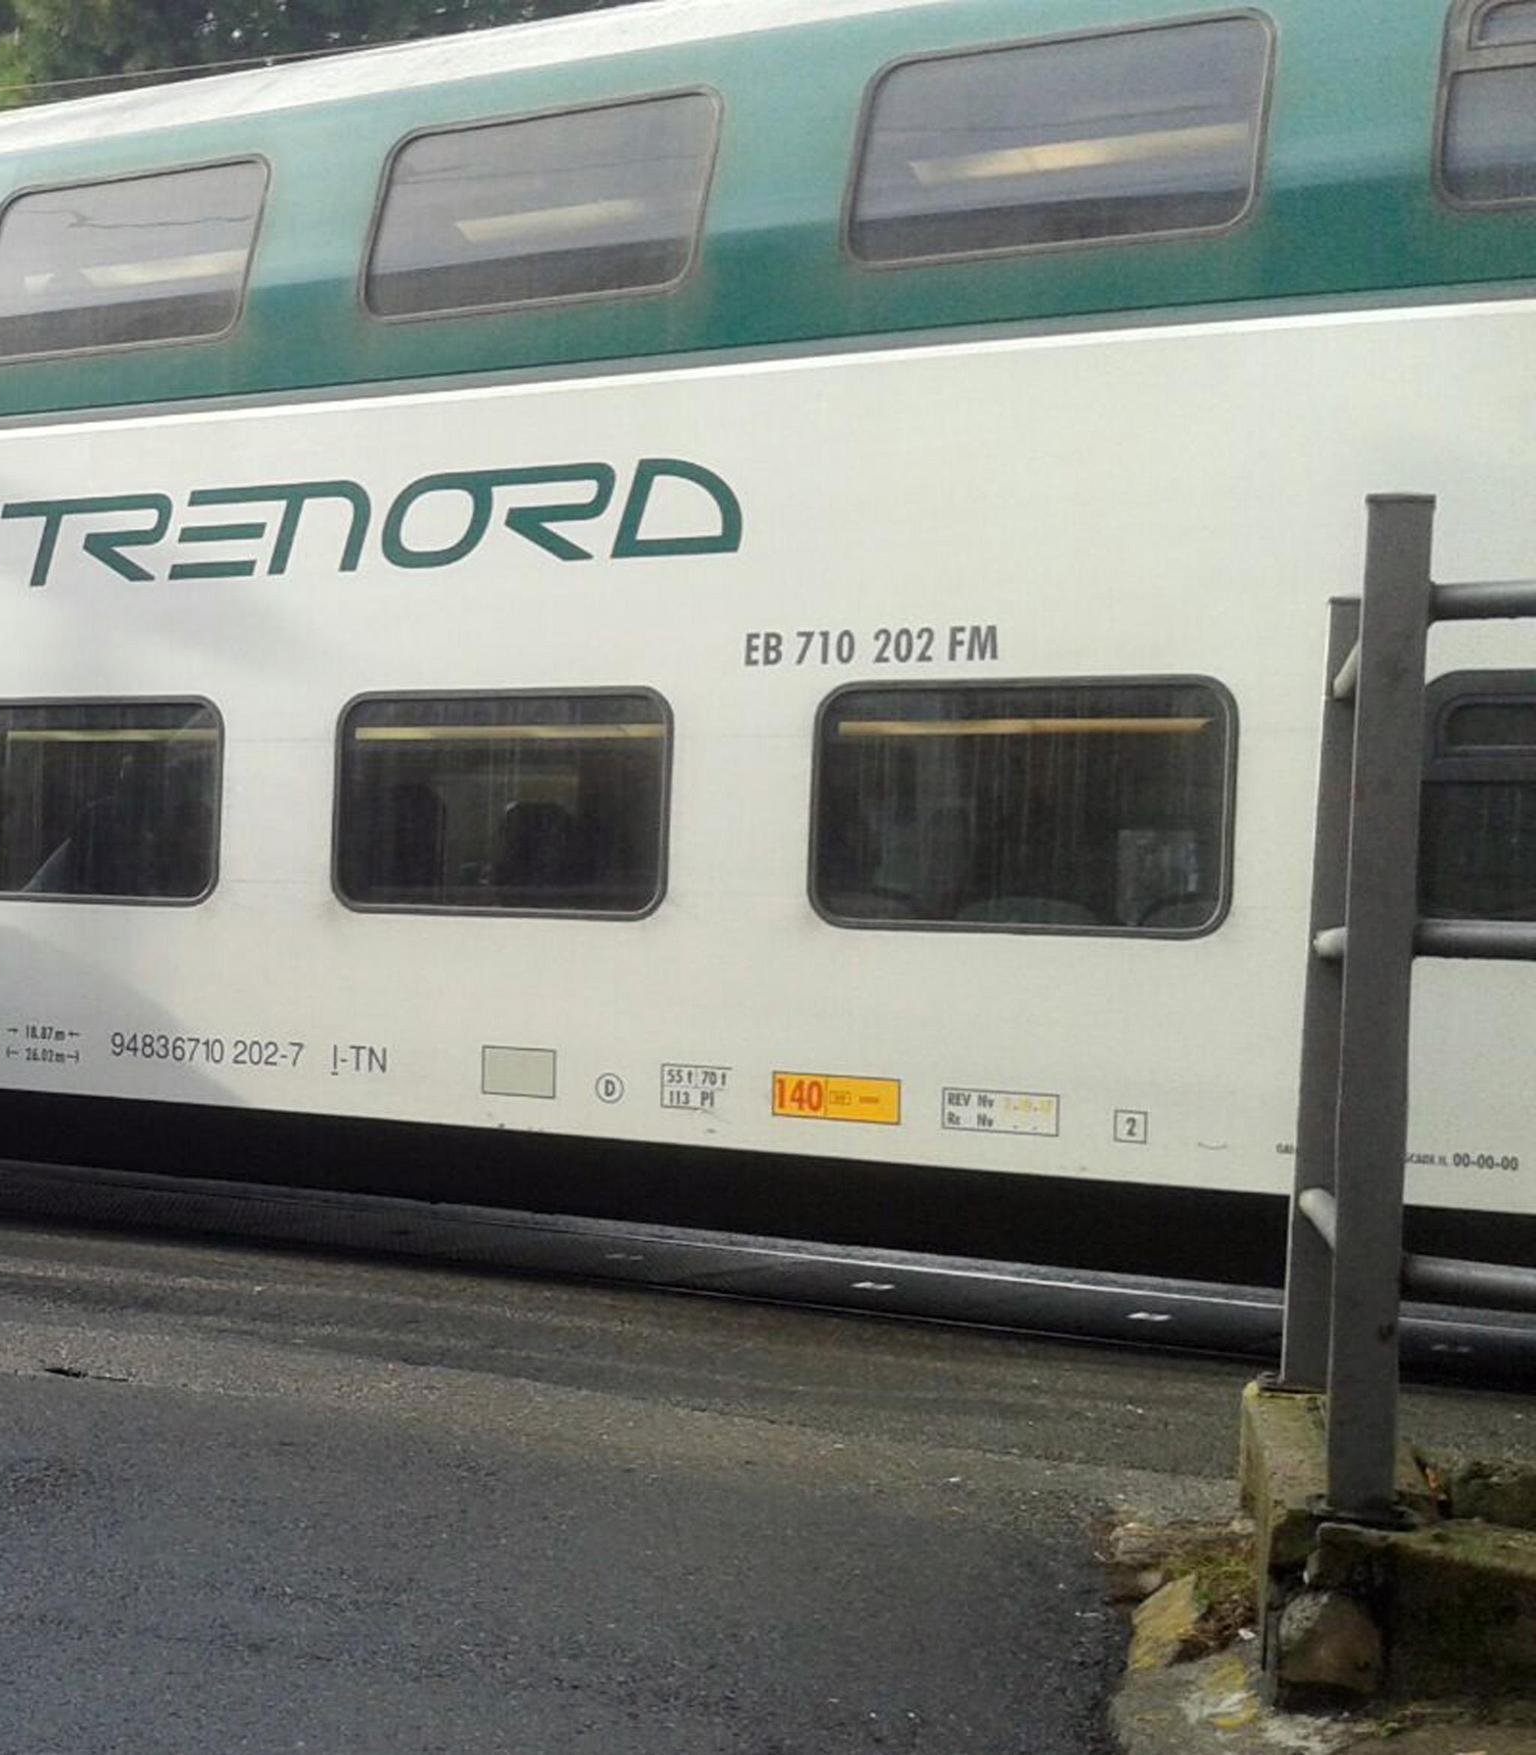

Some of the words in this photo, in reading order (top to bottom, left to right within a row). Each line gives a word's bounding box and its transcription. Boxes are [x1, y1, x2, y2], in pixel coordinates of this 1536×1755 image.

[1, 458, 742, 587] TRENORD
[744, 632, 783, 667] EB
[796, 630, 855, 665] 710
[873, 627, 934, 663] 202
[948, 625, 998, 661] FM
[110, 1031, 226, 1065] 94836710
[232, 1040, 305, 1067] 202-7
[604, 1079, 616, 1097] D
[666, 1069, 683, 1084] 55
[701, 1071, 718, 1086] 70
[669, 1091, 691, 1105] 113
[777, 1078, 823, 1112] 140
[1125, 1116, 1137, 1137] 2
[1453, 1152, 1519, 1171] 00-00-00
